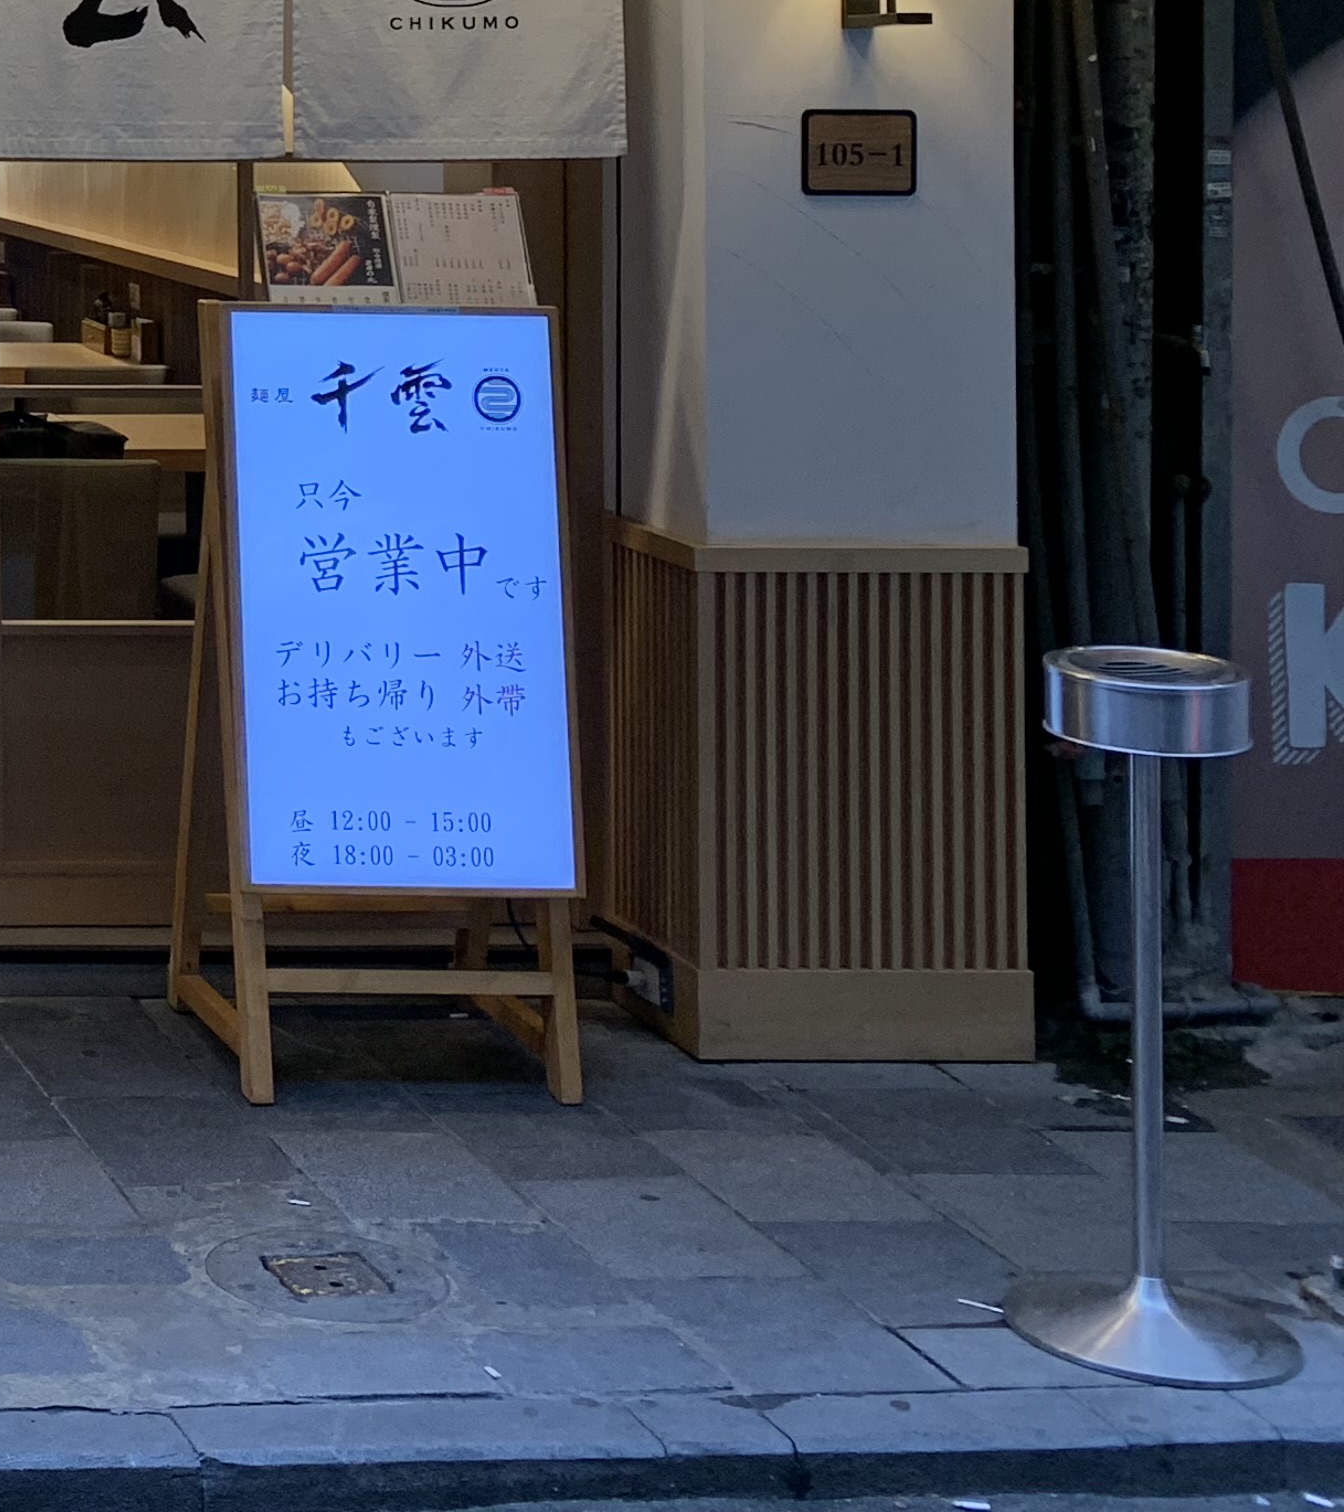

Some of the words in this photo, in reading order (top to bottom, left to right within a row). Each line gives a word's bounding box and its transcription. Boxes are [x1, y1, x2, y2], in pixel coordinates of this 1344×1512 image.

[389, 15, 519, 31] CHIKUMO
[817, 142, 904, 167] 105-1
[295, 479, 362, 511] 只今
[299, 532, 488, 596] 営業中
[495, 575, 547, 600] です
[275, 640, 441, 669] デリバリー
[462, 640, 527, 673] 外送
[277, 677, 434, 711] お持ち帰り
[343, 725, 483, 749] もございます
[290, 809, 314, 833] 昼
[331, 810, 391, 832] 12:00
[431, 811, 492, 833] 15:00
[293, 841, 316, 867] 夜
[334, 844, 394, 866] 18:00
[432, 845, 494, 868] 03:00
